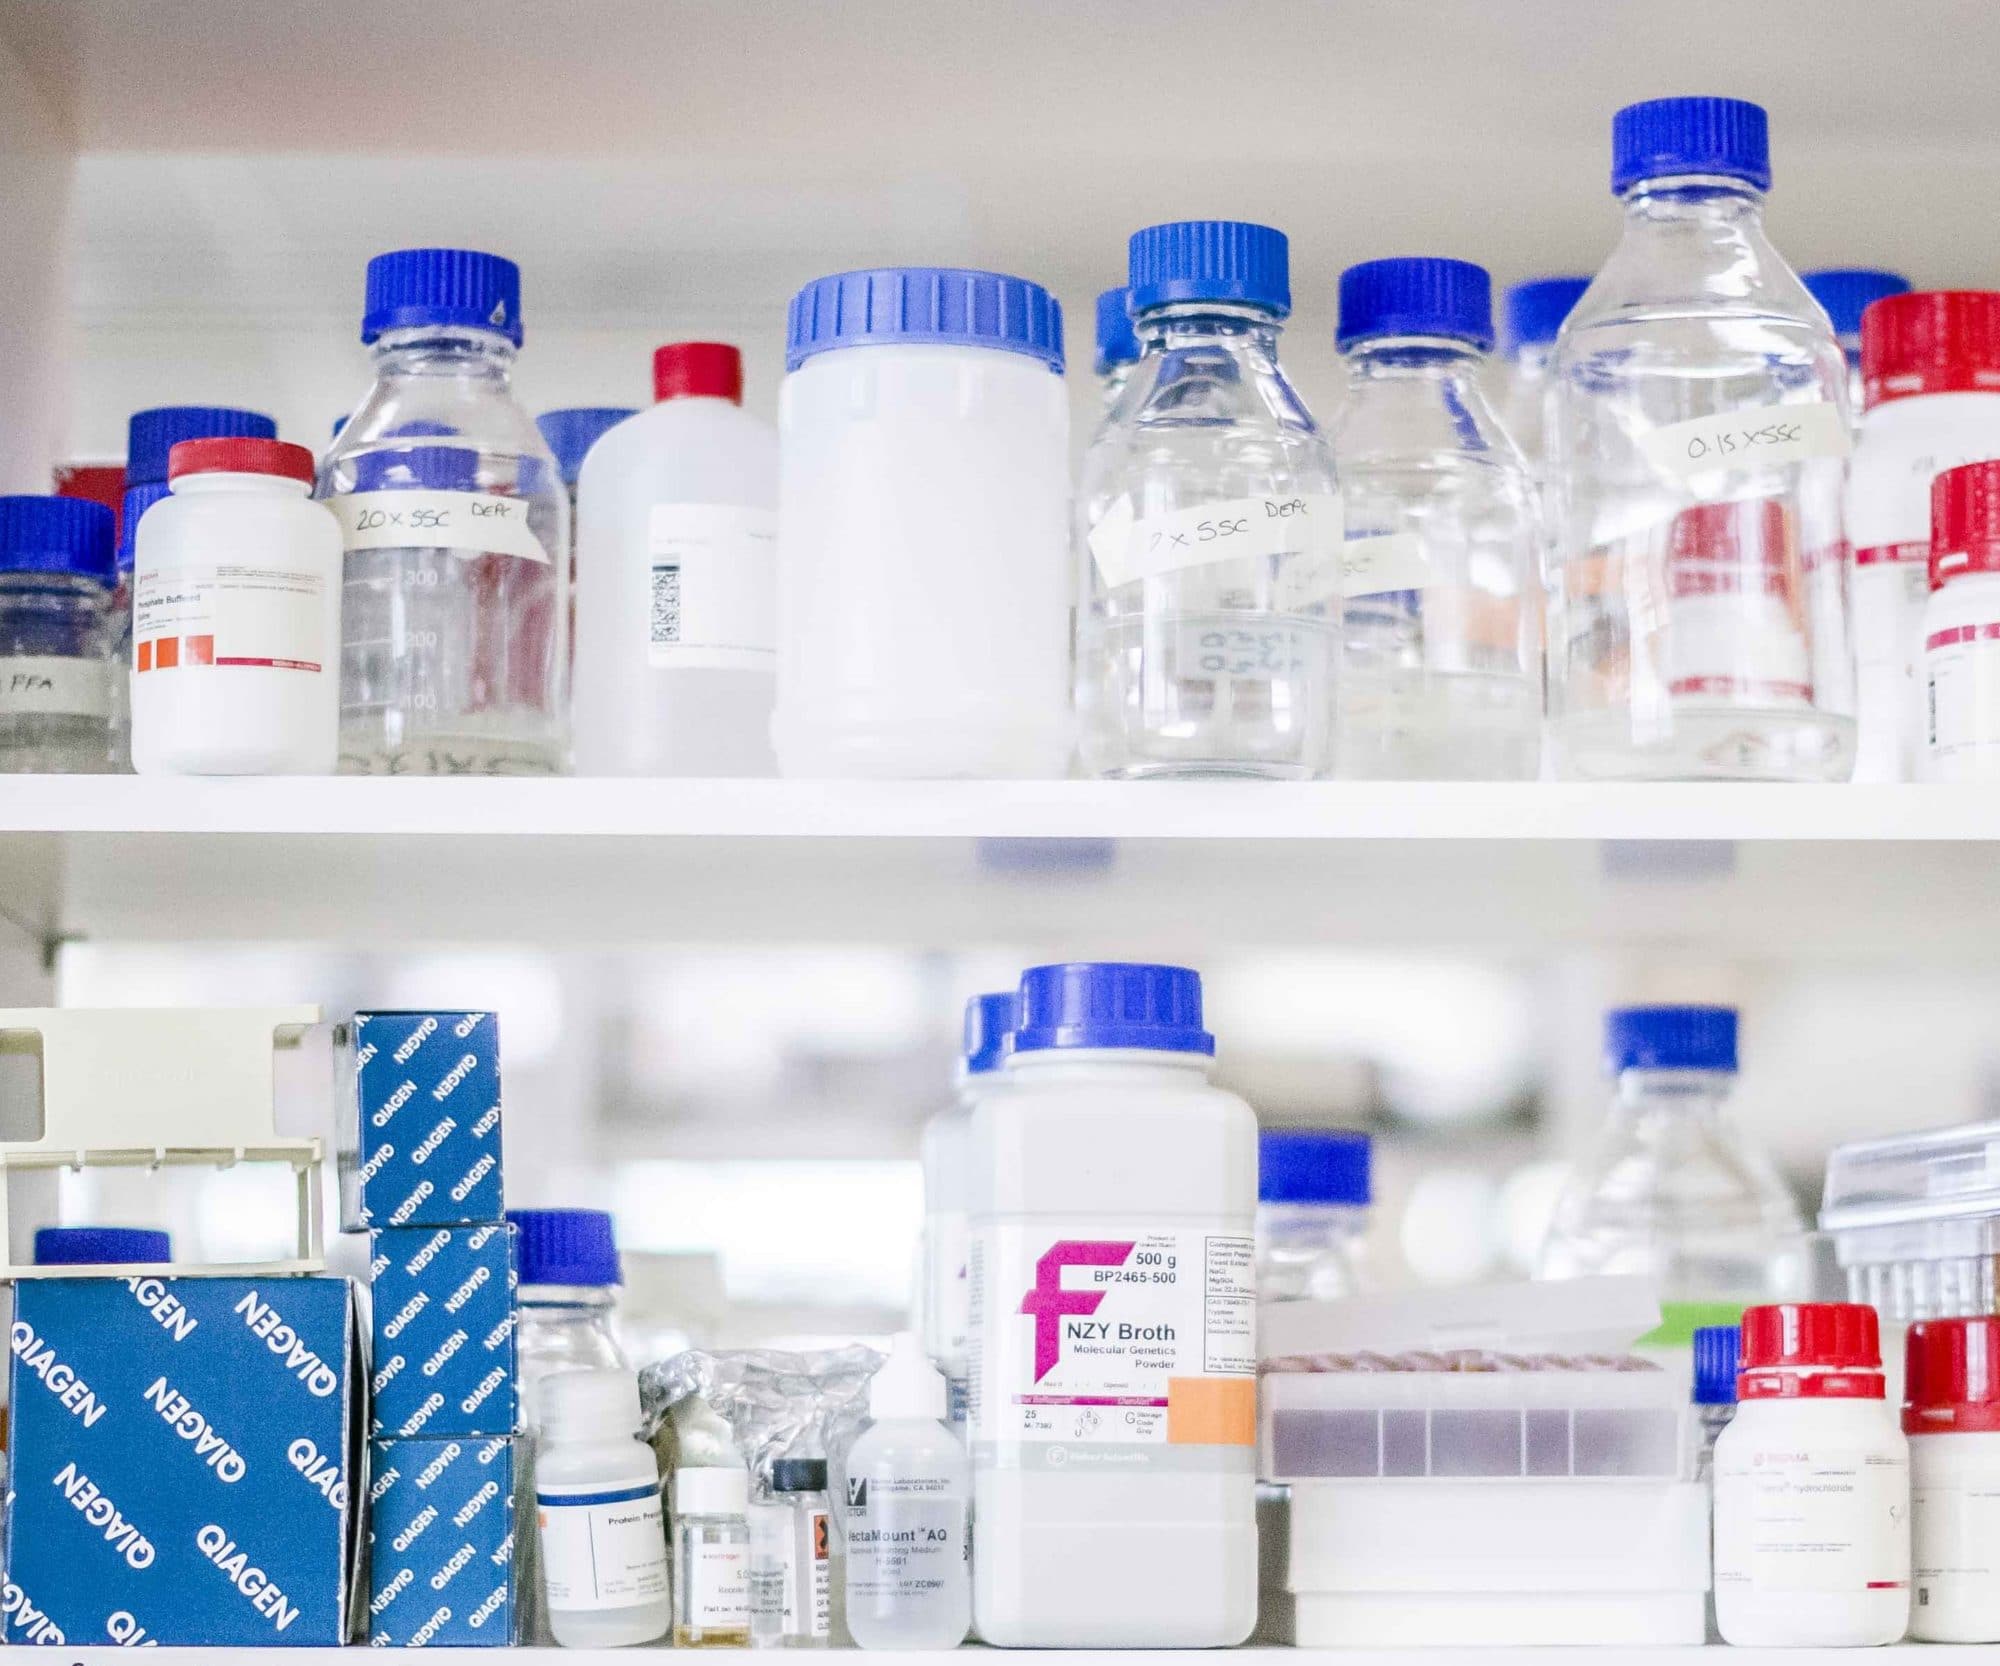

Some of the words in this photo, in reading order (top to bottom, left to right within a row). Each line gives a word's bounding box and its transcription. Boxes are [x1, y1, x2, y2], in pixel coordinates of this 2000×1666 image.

[410, 510, 450, 528] SSC
[1197, 519, 1248, 541] SSC
[393, 1017, 438, 1064] QIAGEN
[432, 1054, 477, 1101] QIAGEN
[372, 1080, 418, 1127] QIAGEN
[412, 1117, 457, 1164] QIAGEN
[451, 1154, 496, 1202] QIAGEN
[389, 1180, 434, 1226] QIAGEN
[406, 1230, 451, 1276] QIAGEN
[1136, 1252, 1162, 1265] 500
[1167, 1256, 1176, 1269] g
[445, 1267, 490, 1313] QIAGEN
[1094, 1271, 1176, 1284] BP2465-500
[384, 1291, 429, 1339] QIAGEN
[1067, 1322, 1110, 1340] NZY
[1118, 1323, 1176, 1341] Broth
[234, 1290, 337, 1397] QIAGEN
[422, 1329, 469, 1376] QIAGEN
[1073, 1345, 1126, 1355] Molecular
[1129, 1345, 1176, 1356] Genetics
[1135, 1359, 1175, 1369] Powder
[10, 1322, 107, 1428] QIAGEN
[461, 1366, 507, 1414] QIAGEN
[144, 1376, 246, 1483] QIAGEN
[399, 1393, 444, 1437] QIAGEN
[1025, 1410, 1037, 1419] 25
[415, 1443, 461, 1489] QIAGEN
[53, 1462, 155, 1569] QIAGEN
[453, 1481, 499, 1527] QIAGEN
[608, 1514, 641, 1526] Protein
[393, 1505, 438, 1552] QIAGEN
[927, 1528, 948, 1541] AQ
[196, 1524, 300, 1631] QIAGEN
[430, 1543, 476, 1590] QIAGEN
[370, 1568, 414, 1615] QIAGEN
